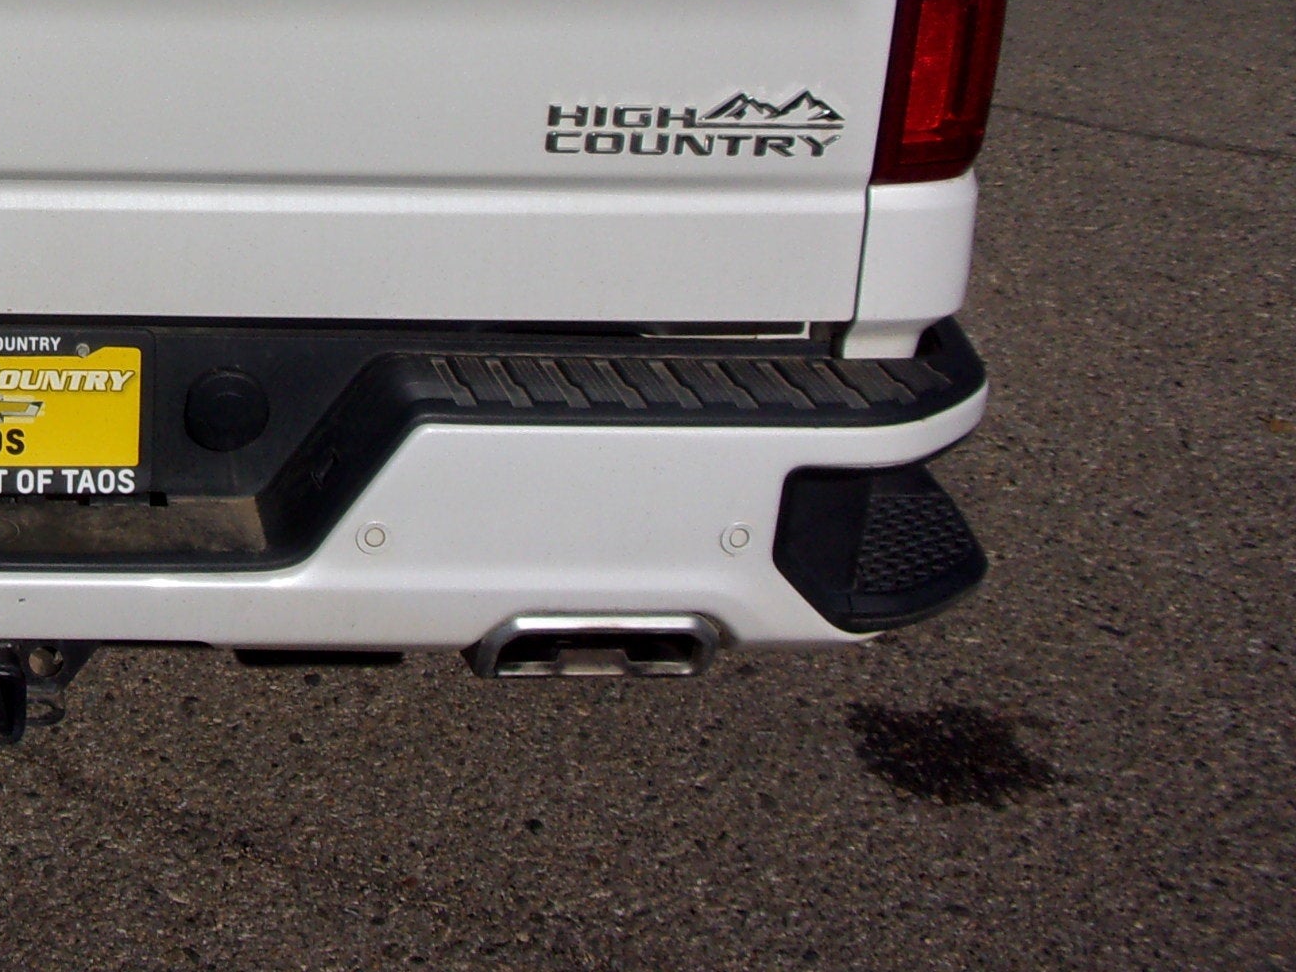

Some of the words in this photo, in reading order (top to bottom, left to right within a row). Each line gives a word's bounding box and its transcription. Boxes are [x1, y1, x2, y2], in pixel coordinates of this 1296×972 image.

[547, 104, 697, 128] HIGH
[545, 130, 842, 158] COUNTRY
[16, 469, 54, 494] OF
[62, 469, 135, 494] TAOS
